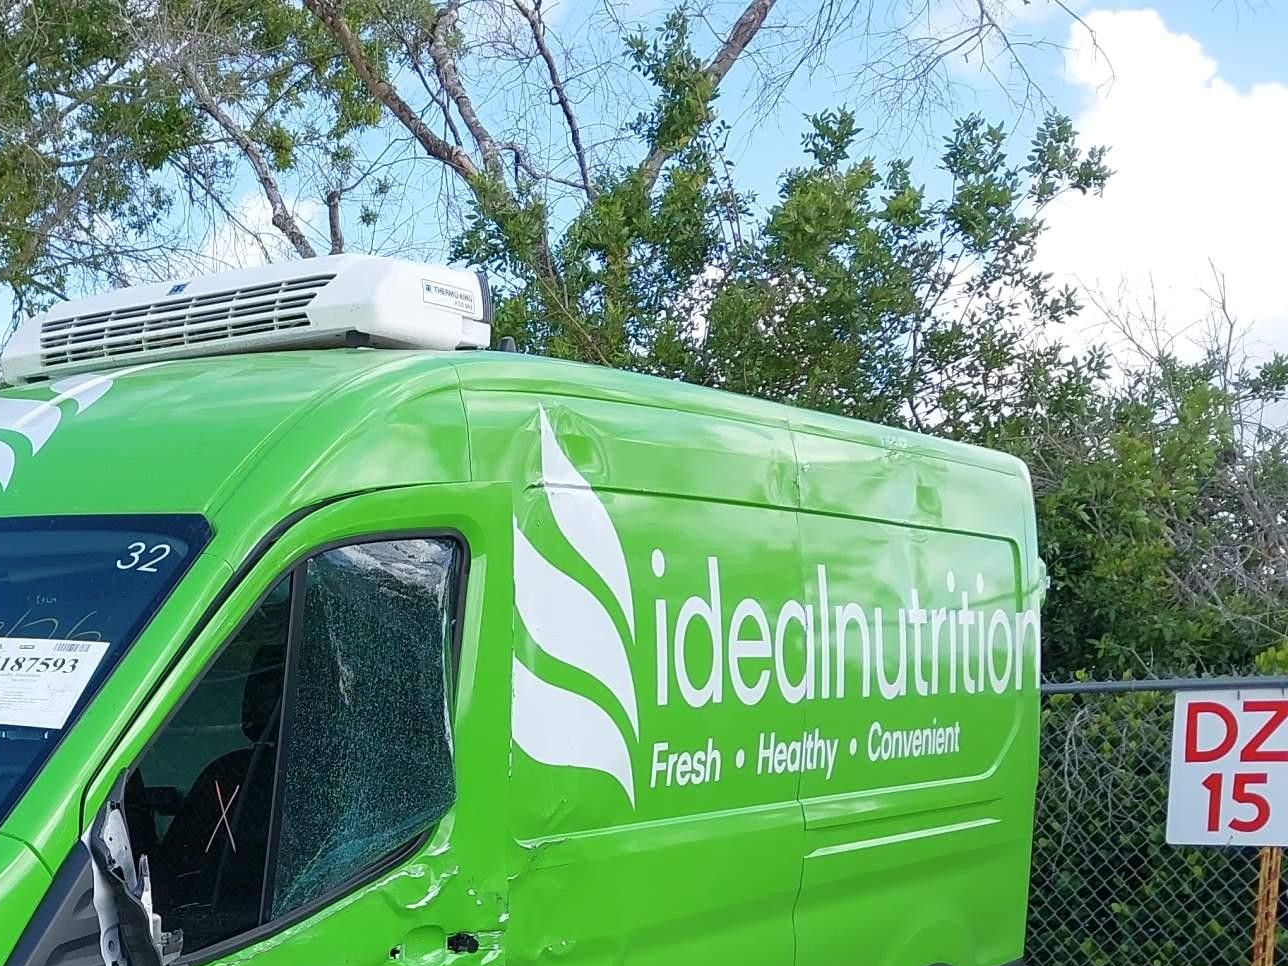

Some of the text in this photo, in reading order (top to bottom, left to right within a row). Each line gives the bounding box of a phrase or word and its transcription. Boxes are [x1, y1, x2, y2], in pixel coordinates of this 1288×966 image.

[116, 541, 171, 573] 32
[651, 548, 1041, 708] idealnutrition
[650, 717, 961, 789] Fresh Healthy Convenient
[1184, 700, 1288, 763] DZ
[1201, 772, 1271, 832] 15
